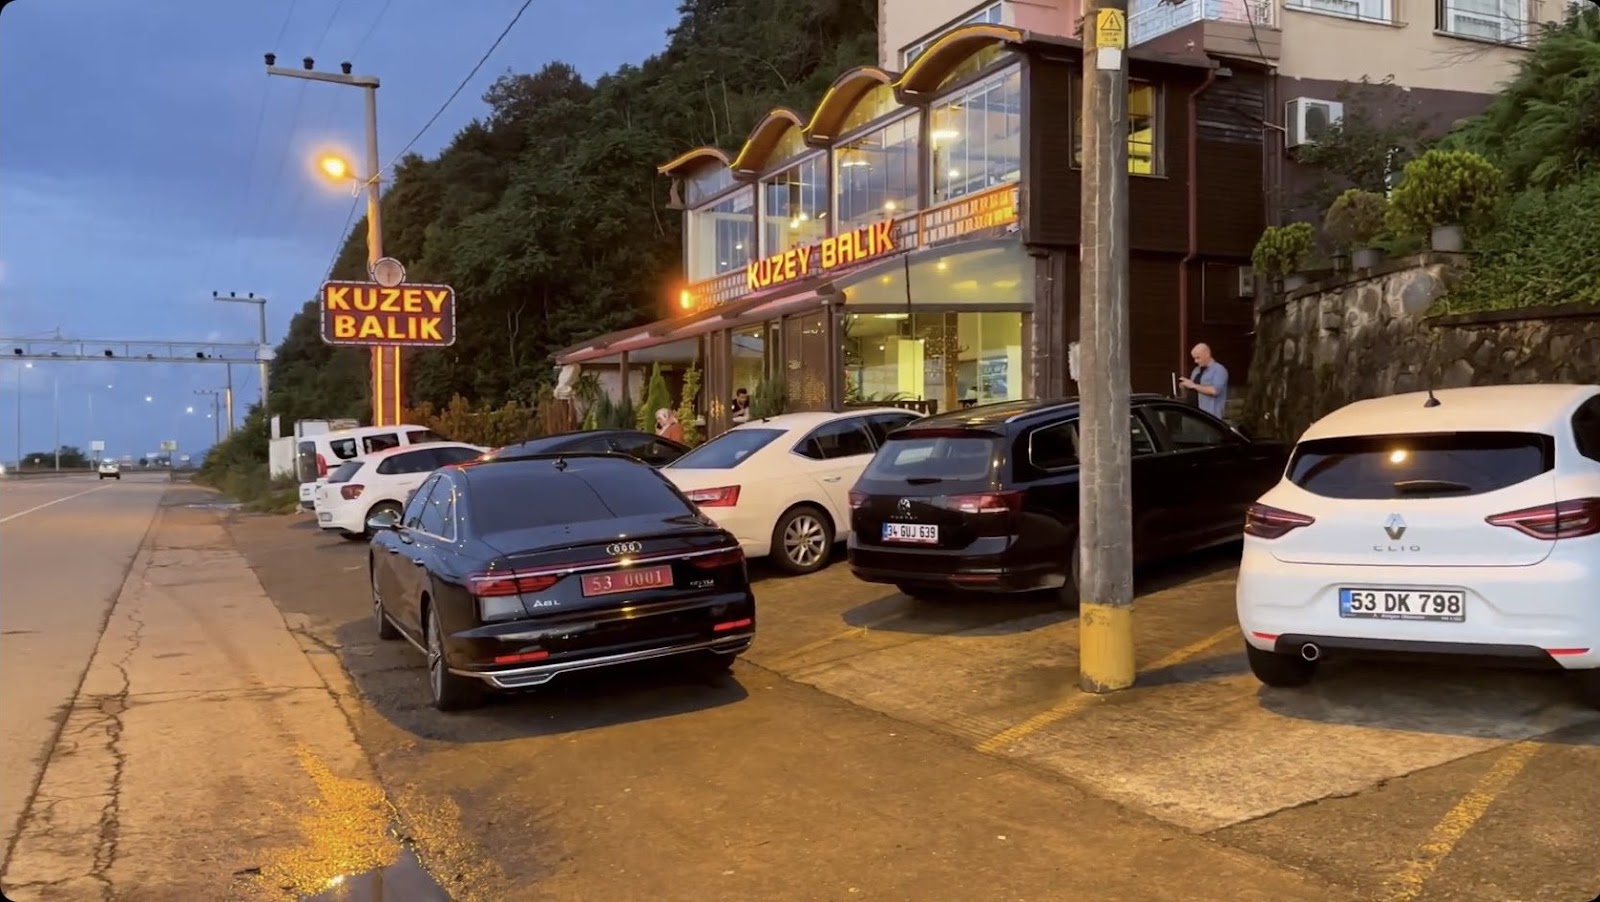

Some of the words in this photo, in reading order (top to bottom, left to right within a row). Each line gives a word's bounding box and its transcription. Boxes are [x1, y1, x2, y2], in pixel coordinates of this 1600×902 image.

[747, 245, 812, 290] KUZEY
[821, 218, 895, 269] BALIK
[327, 286, 449, 313] KUZEY
[334, 314, 443, 341] BALIK
[887, 525, 898, 536] 34
[901, 525, 916, 538] GUJ
[919, 526, 936, 539] 639
[592, 576, 612, 591] 53
[624, 570, 663, 586] 0001
[1351, 593, 1376, 611] 53
[1384, 593, 1411, 612] DK
[1419, 595, 1461, 614] 798
